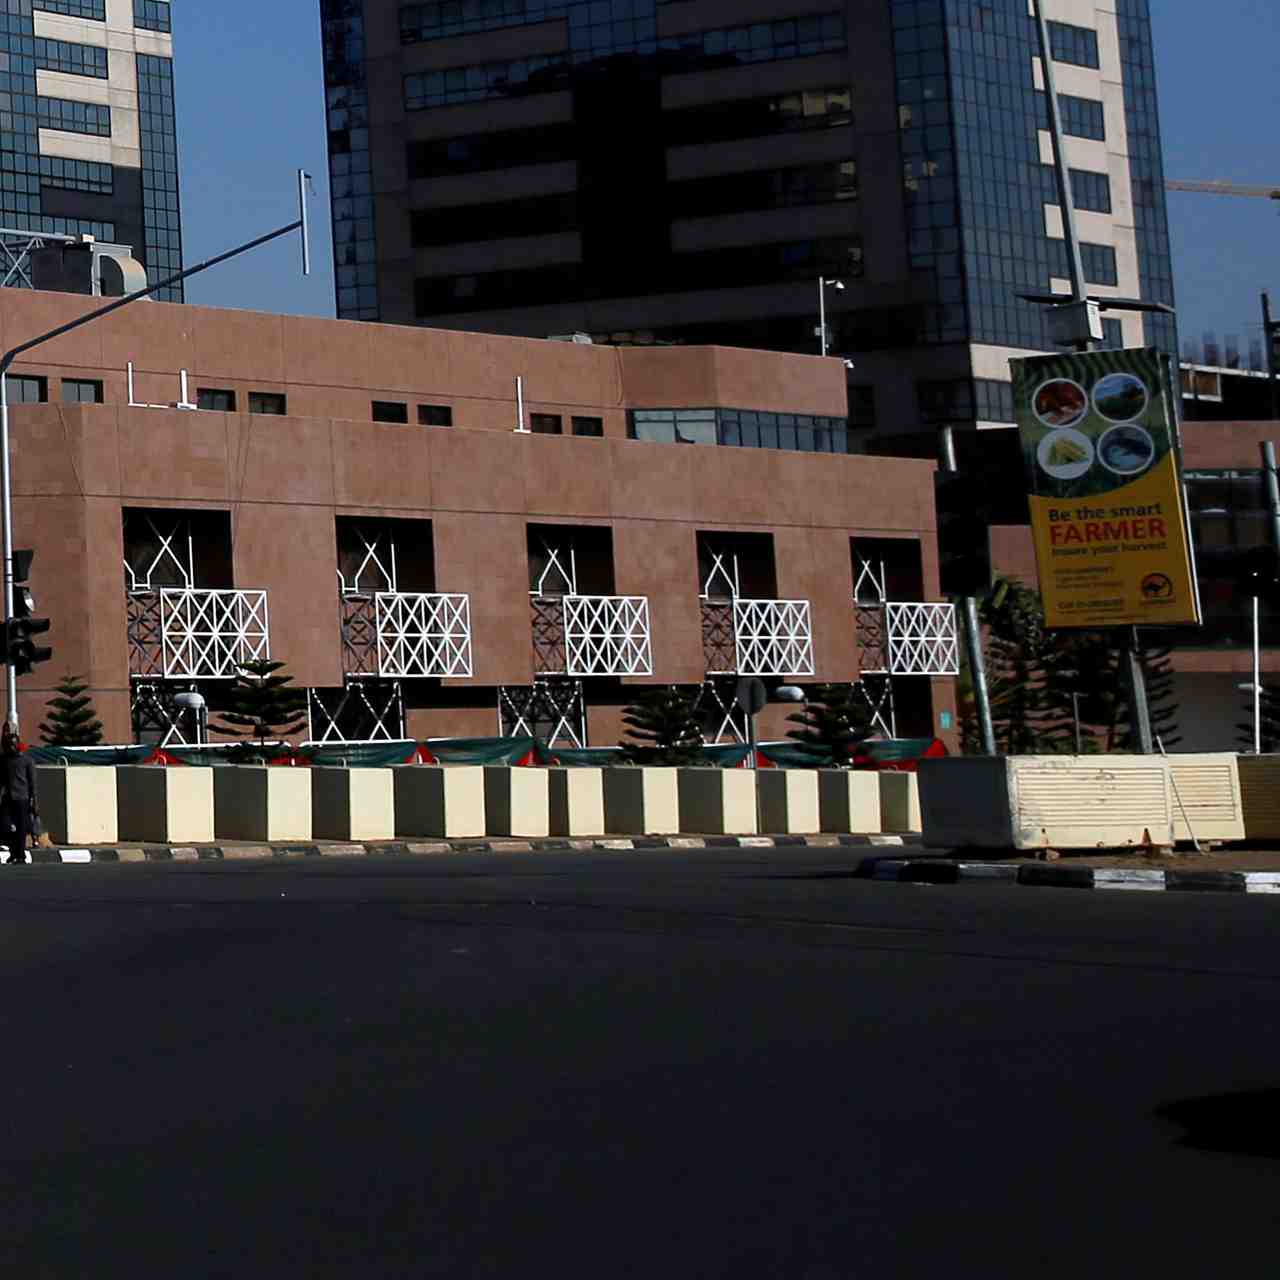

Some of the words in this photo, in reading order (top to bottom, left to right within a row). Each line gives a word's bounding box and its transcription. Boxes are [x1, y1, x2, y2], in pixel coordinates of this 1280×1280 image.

[1048, 508, 1071, 522] Be
[1075, 505, 1105, 520] the
[1110, 502, 1163, 518] smart
[1049, 517, 1167, 546] FARMER
